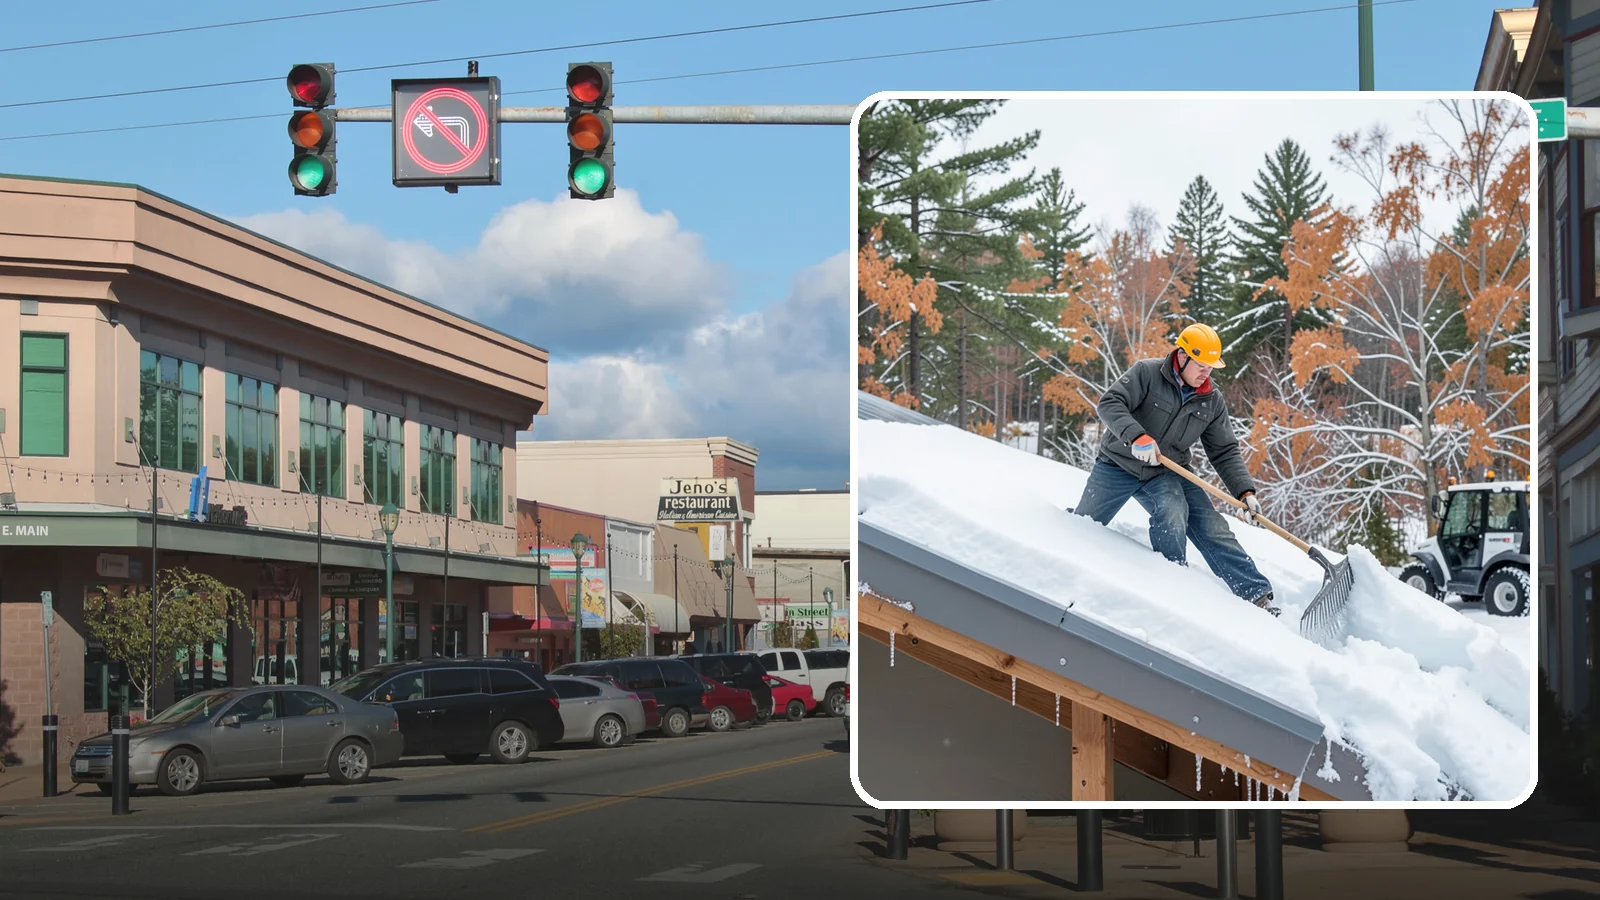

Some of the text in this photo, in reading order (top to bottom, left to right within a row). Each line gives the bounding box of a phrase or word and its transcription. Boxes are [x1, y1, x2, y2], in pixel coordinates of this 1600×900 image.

[669, 479, 727, 495] Jeno's
[665, 496, 731, 509] restaurant
[658, 509, 682, 520] Italian
[686, 509, 714, 520] American
[714, 509, 737, 520] Cuisine
[2, 525, 49, 536] E. MAIN
[785, 607, 828, 617] in Street
[790, 619, 823, 627] lass
